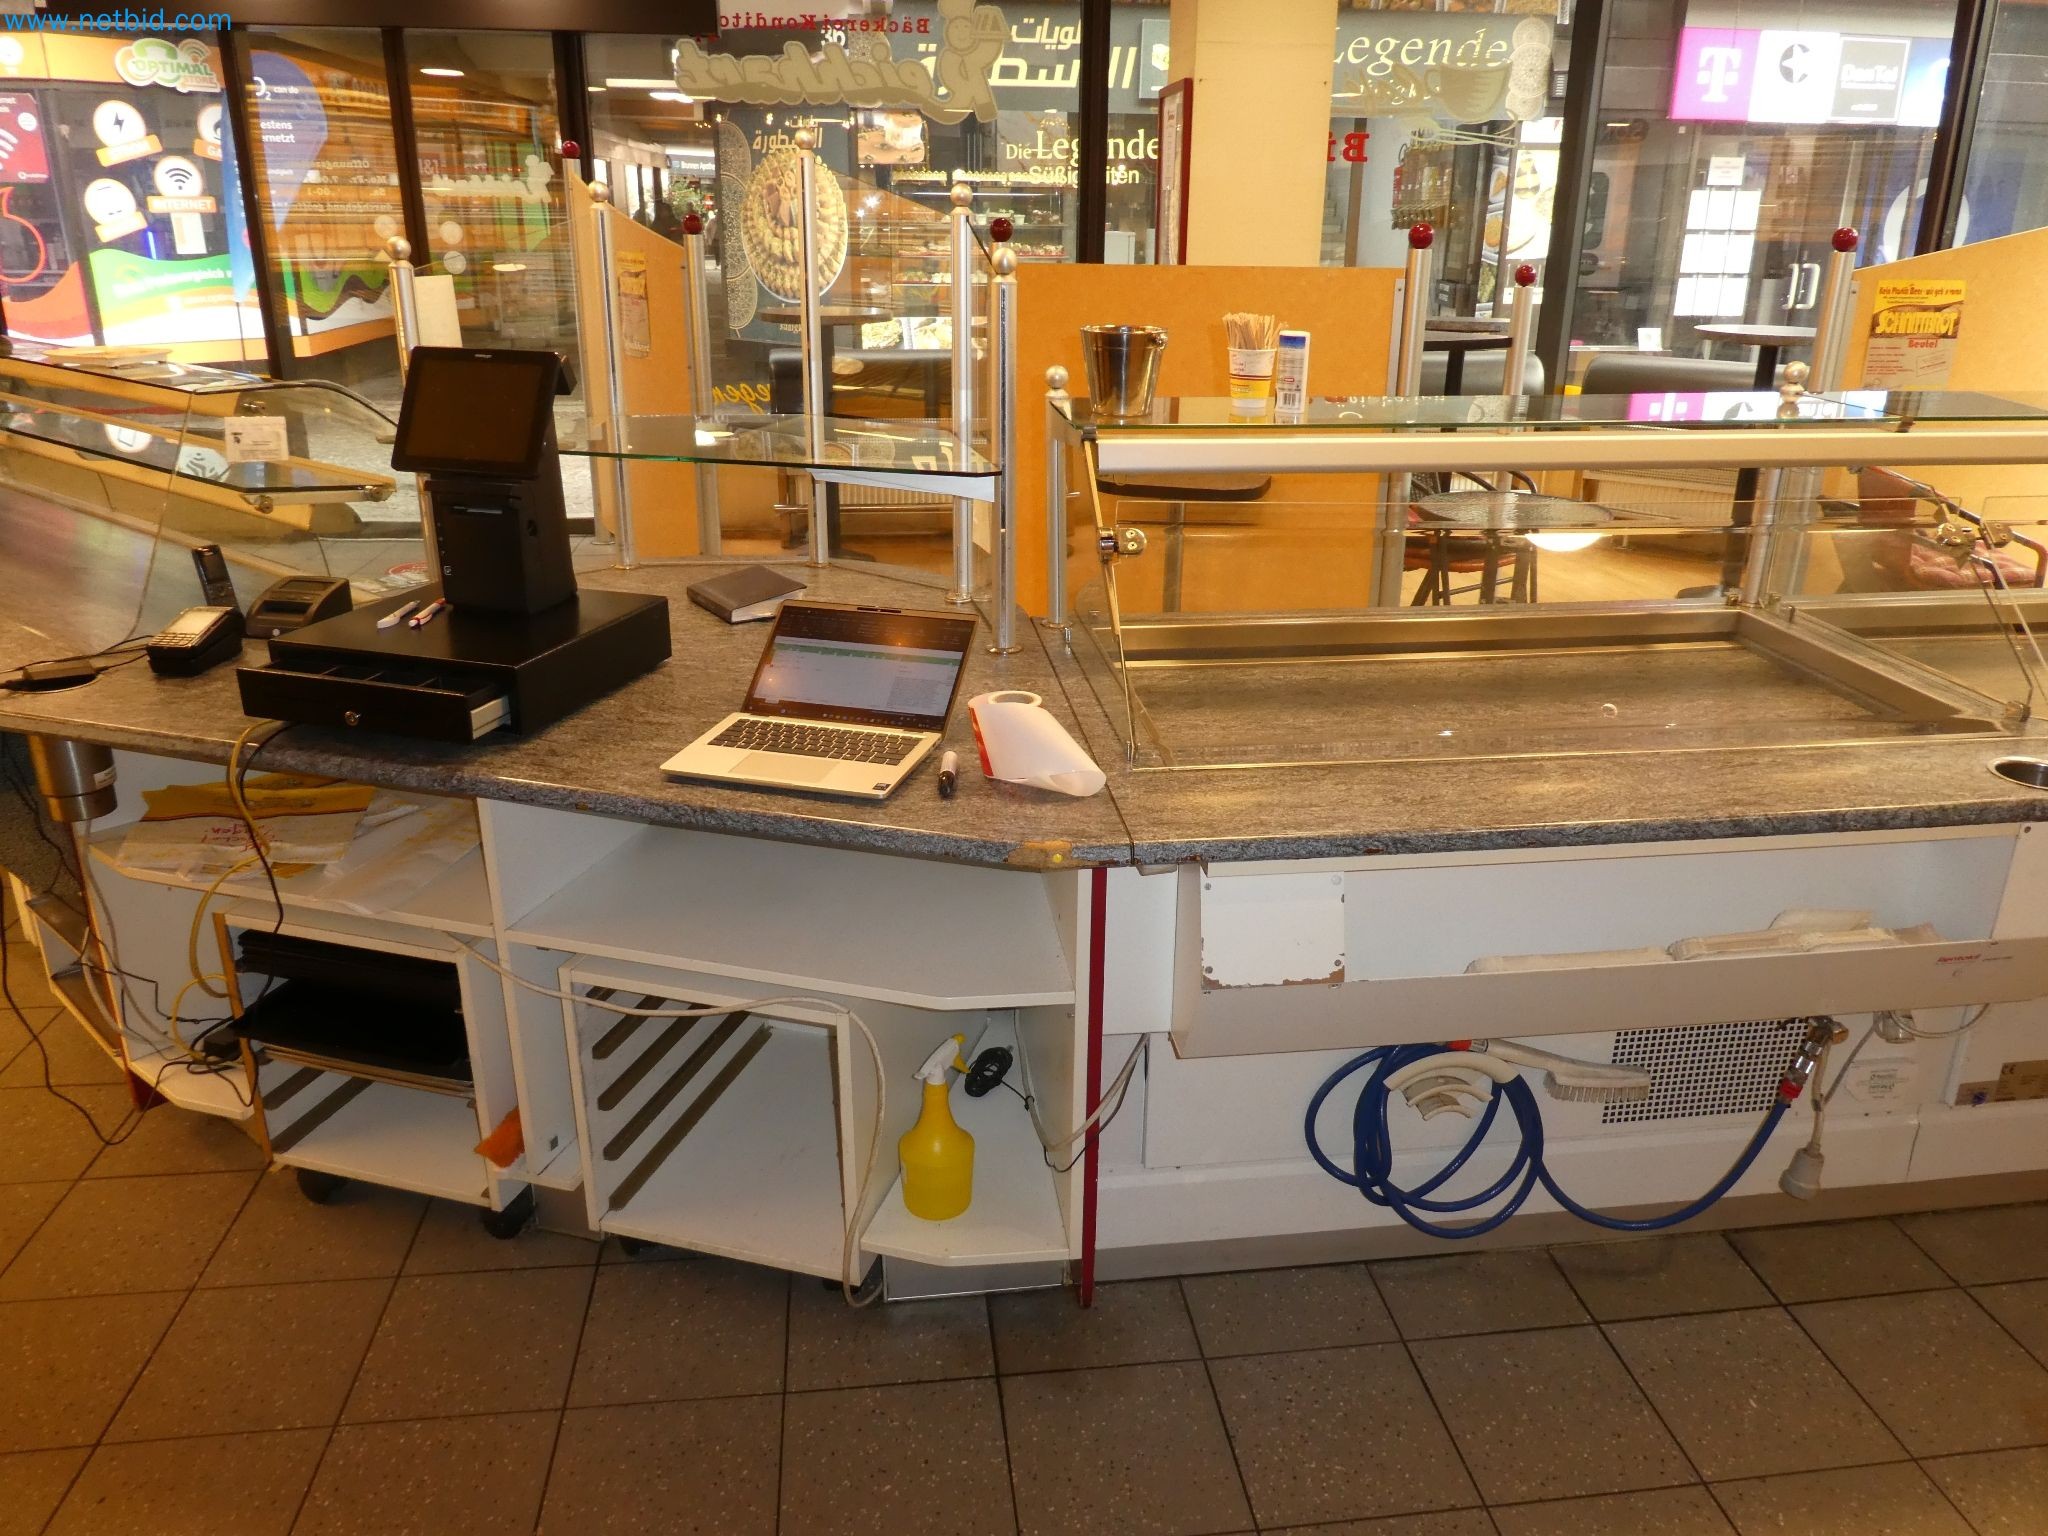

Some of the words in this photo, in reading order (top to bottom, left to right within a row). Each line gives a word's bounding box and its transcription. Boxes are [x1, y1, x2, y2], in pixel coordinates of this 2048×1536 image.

[132, 60, 213, 76] OPTIMAL
[260, 120, 293, 130] estens
[1908, 340, 1938, 349] Beutel
